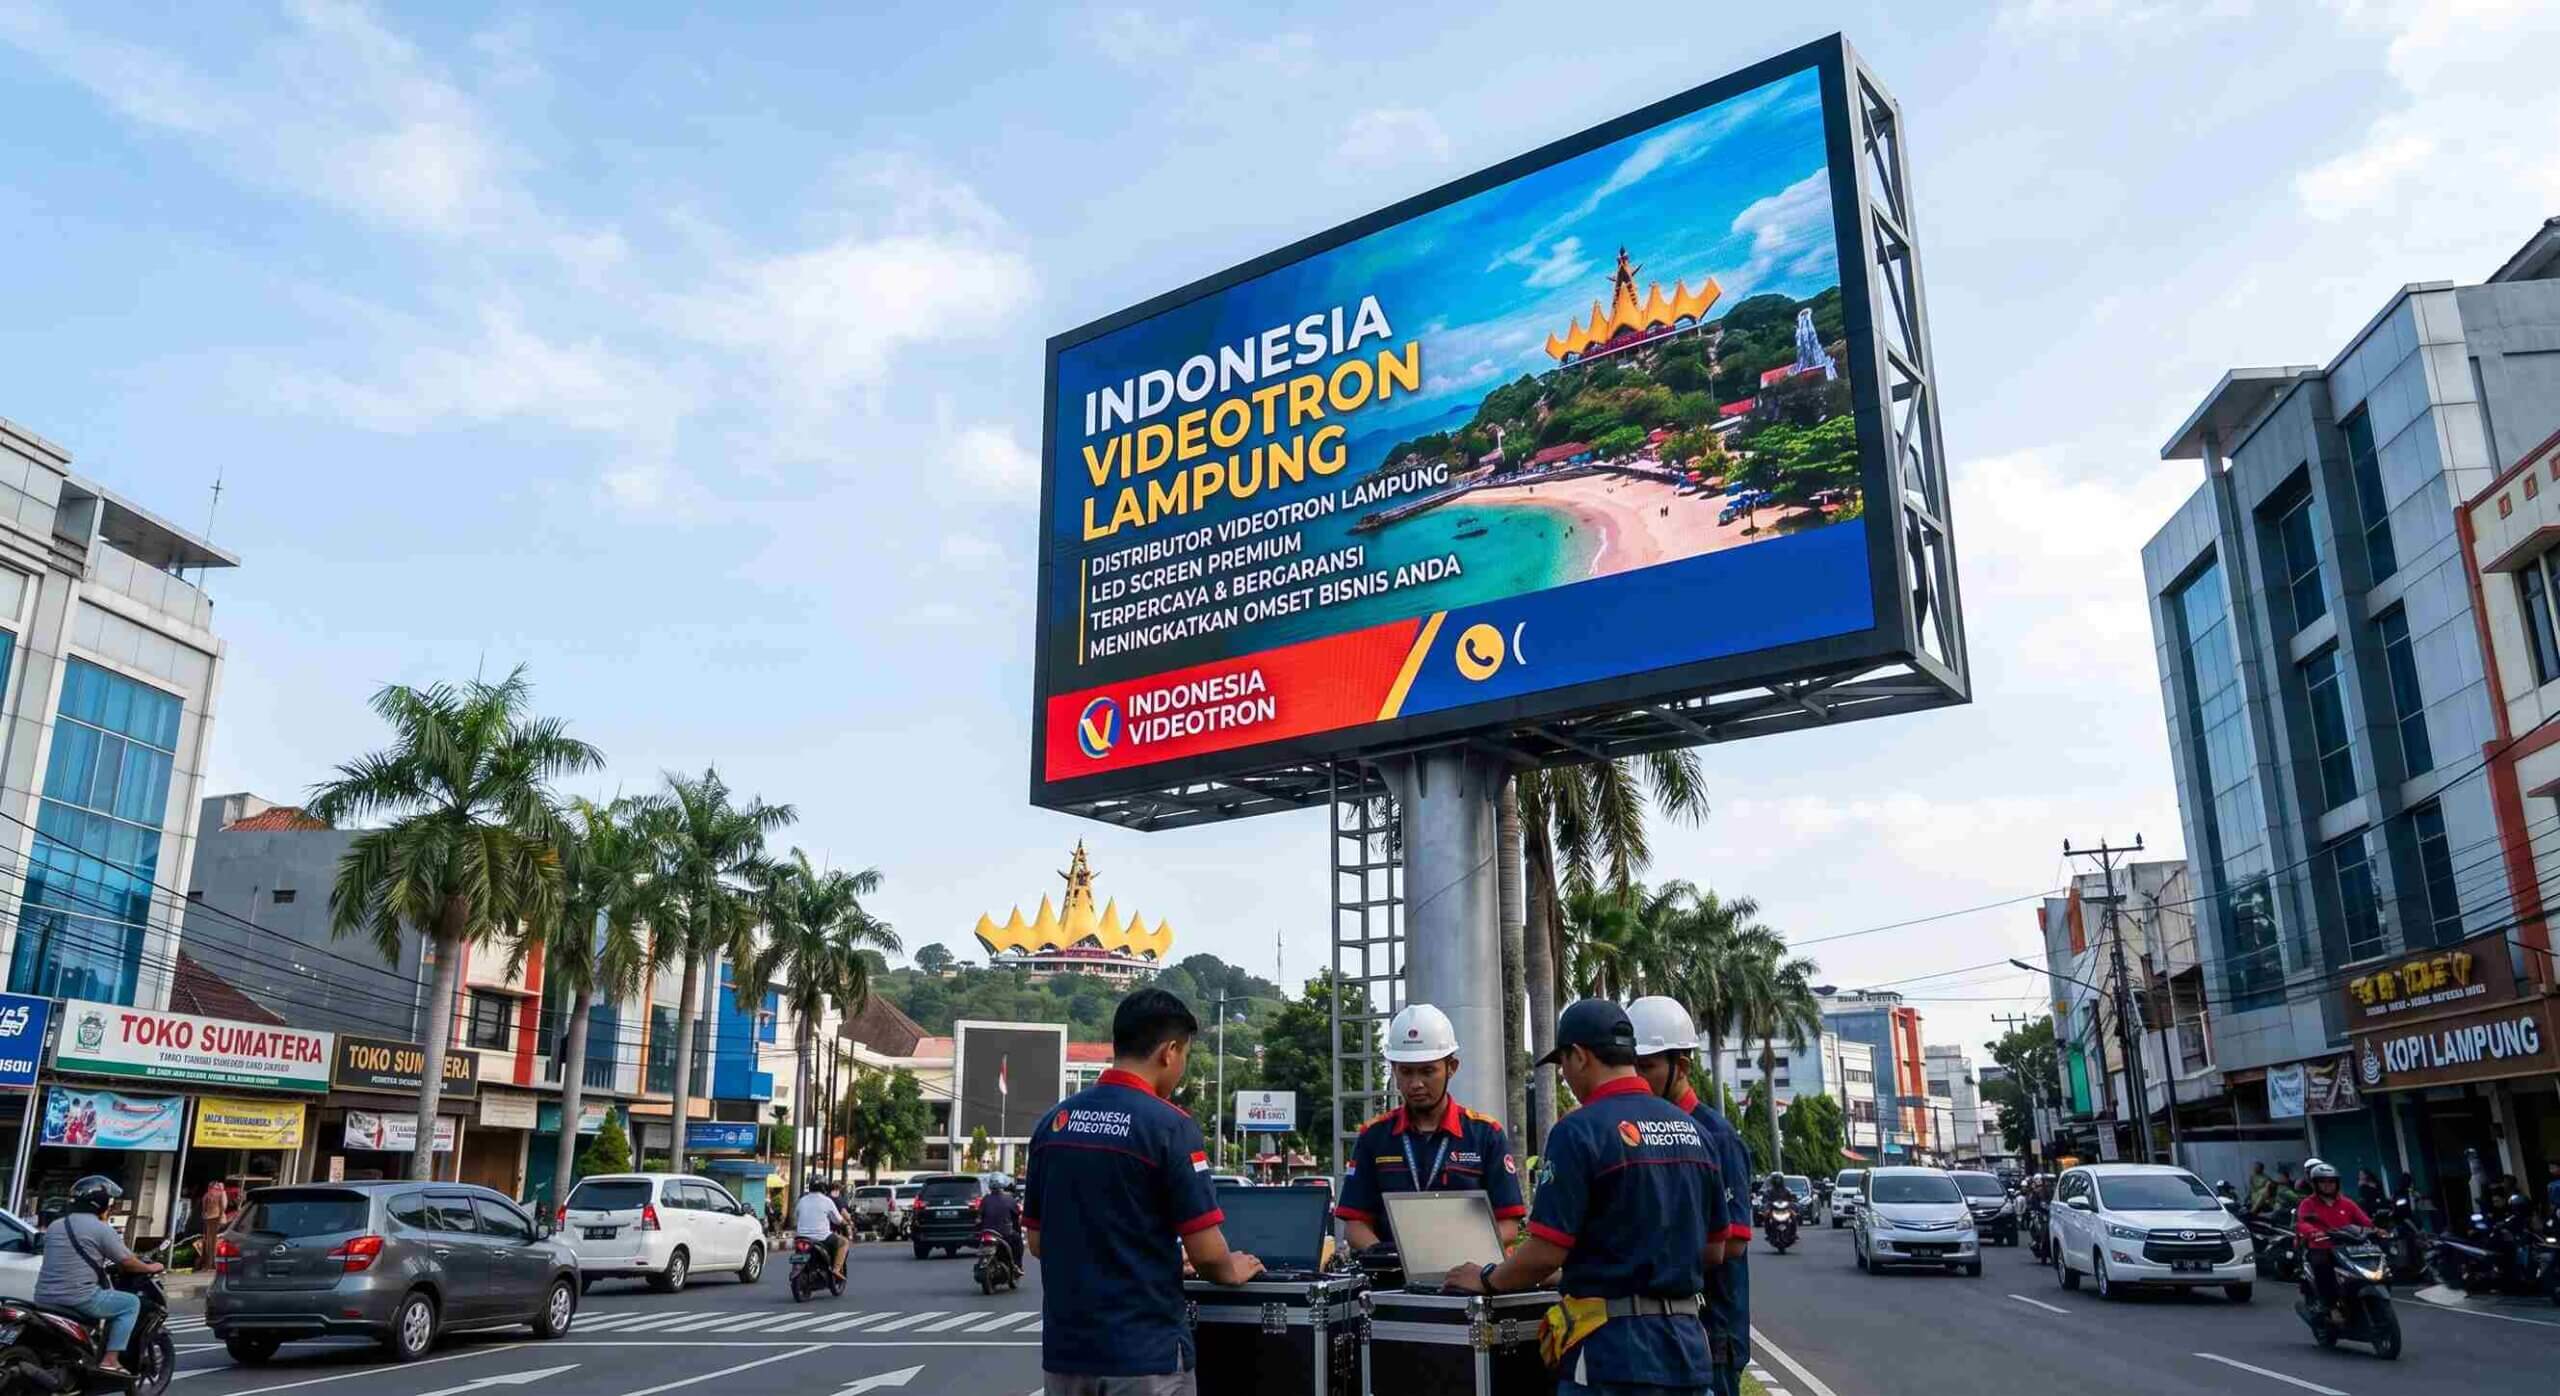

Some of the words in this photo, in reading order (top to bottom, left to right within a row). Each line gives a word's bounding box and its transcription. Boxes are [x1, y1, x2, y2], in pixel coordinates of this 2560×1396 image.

[1085, 295, 1392, 437] INDONESIA
[1084, 341, 1420, 487] VIDEOTRON
[1083, 425, 1347, 541] LAMPUNG
[1092, 527, 1213, 577] DISTRIBUTOR
[1217, 492, 1335, 543] VIDEOTRON
[1341, 463, 1449, 510] LAMPUNG
[1090, 585, 1210, 632] TERPERCAYA
[1214, 580, 1228, 601] &
[1232, 545, 1365, 597] BERGARANSI
[1091, 579, 1126, 604] LED
[1130, 557, 1203, 594] SCREEN
[1208, 531, 1301, 575] PREMIUM
[1090, 606, 1238, 660] MENINGKATKAN
[1243, 588, 1314, 623] OMSET
[1319, 571, 1389, 606] BISNIS
[1394, 553, 1462, 589] ANDA
[1128, 669, 1266, 718] INDONESIA
[1128, 696, 1276, 745] VIDEOTRON
[121, 1014, 193, 1049] TOKO
[200, 1024, 323, 1064] SUMATERA
[349, 1045, 390, 1071] TOKO
[2382, 1033, 2428, 1073] KOPI
[2430, 1016, 2539, 1067] LAMPUNG
[1068, 1120, 1130, 1137] VIDEOTRON
[1070, 1110, 1131, 1125] INDONESIA
[1637, 1121, 1698, 1135] INDONESIA
[1641, 1133, 1702, 1147] VIDEOTRON
